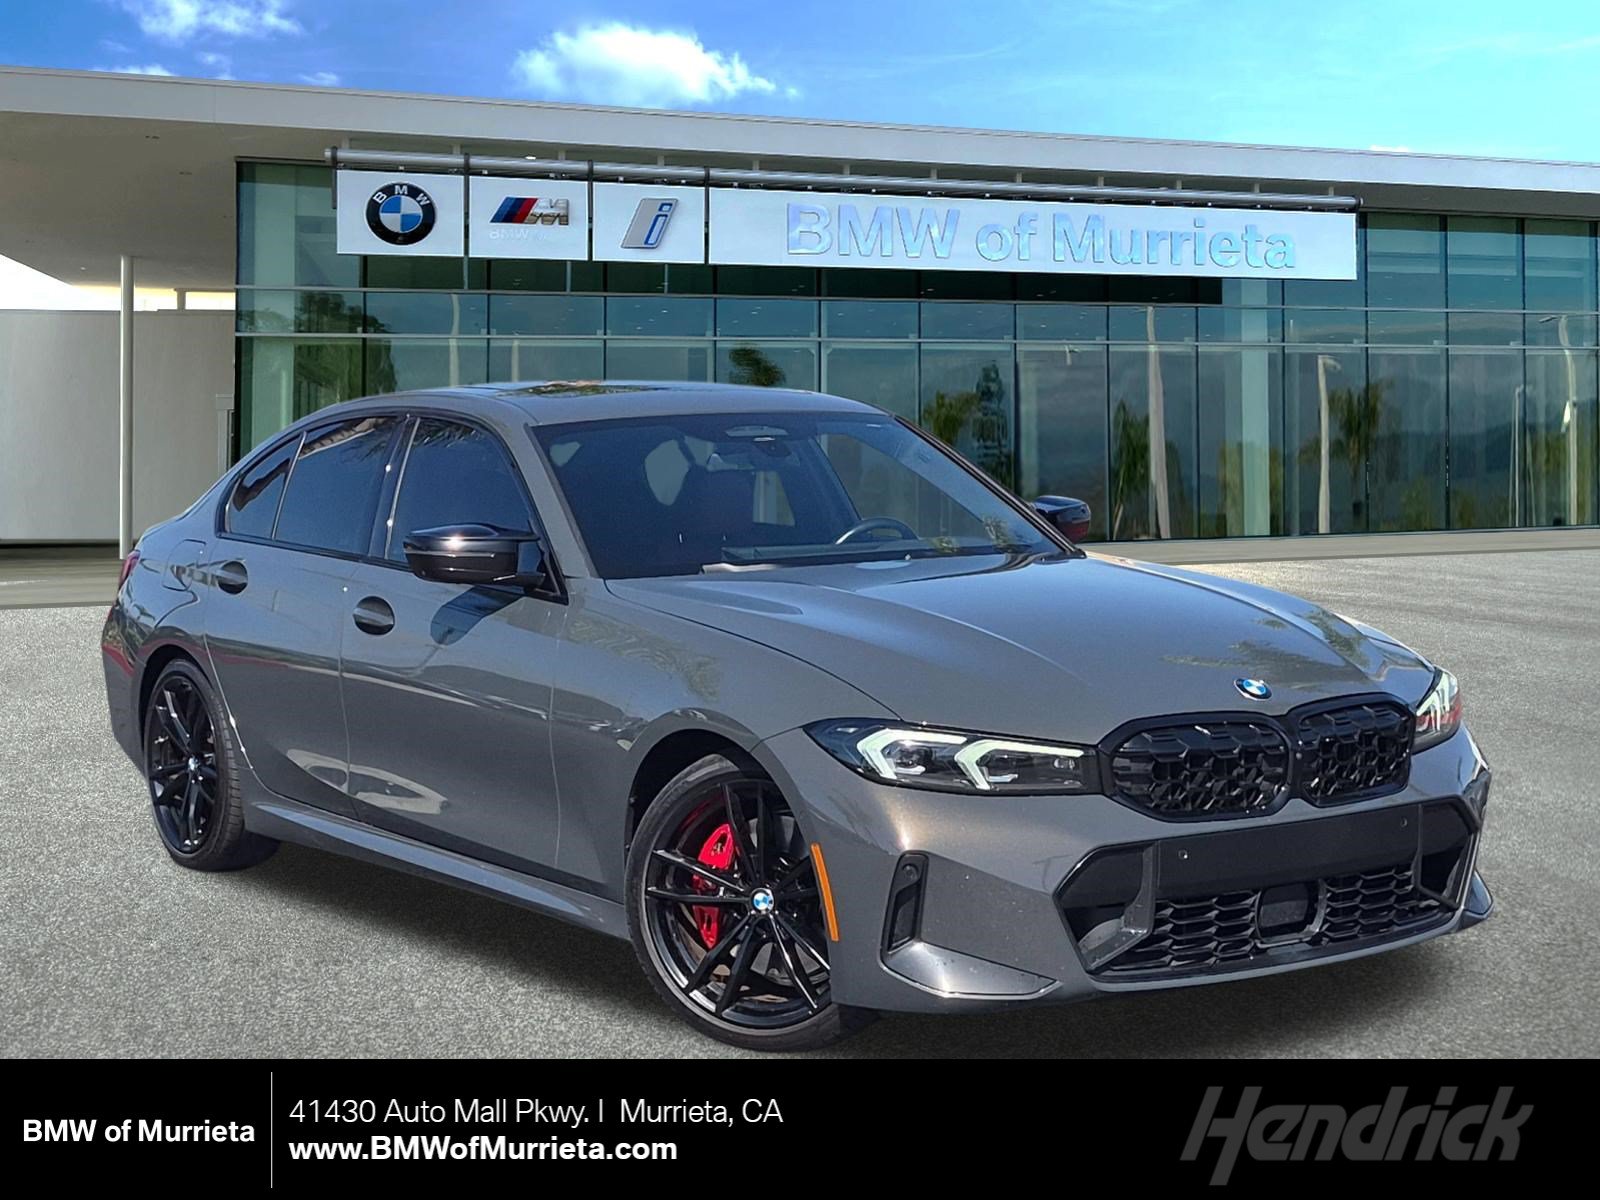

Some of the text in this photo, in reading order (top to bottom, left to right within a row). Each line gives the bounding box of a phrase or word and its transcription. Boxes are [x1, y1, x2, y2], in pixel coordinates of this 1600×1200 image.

[372, 184, 430, 206] BMW
[787, 203, 1296, 268] BMW of Murrieta
